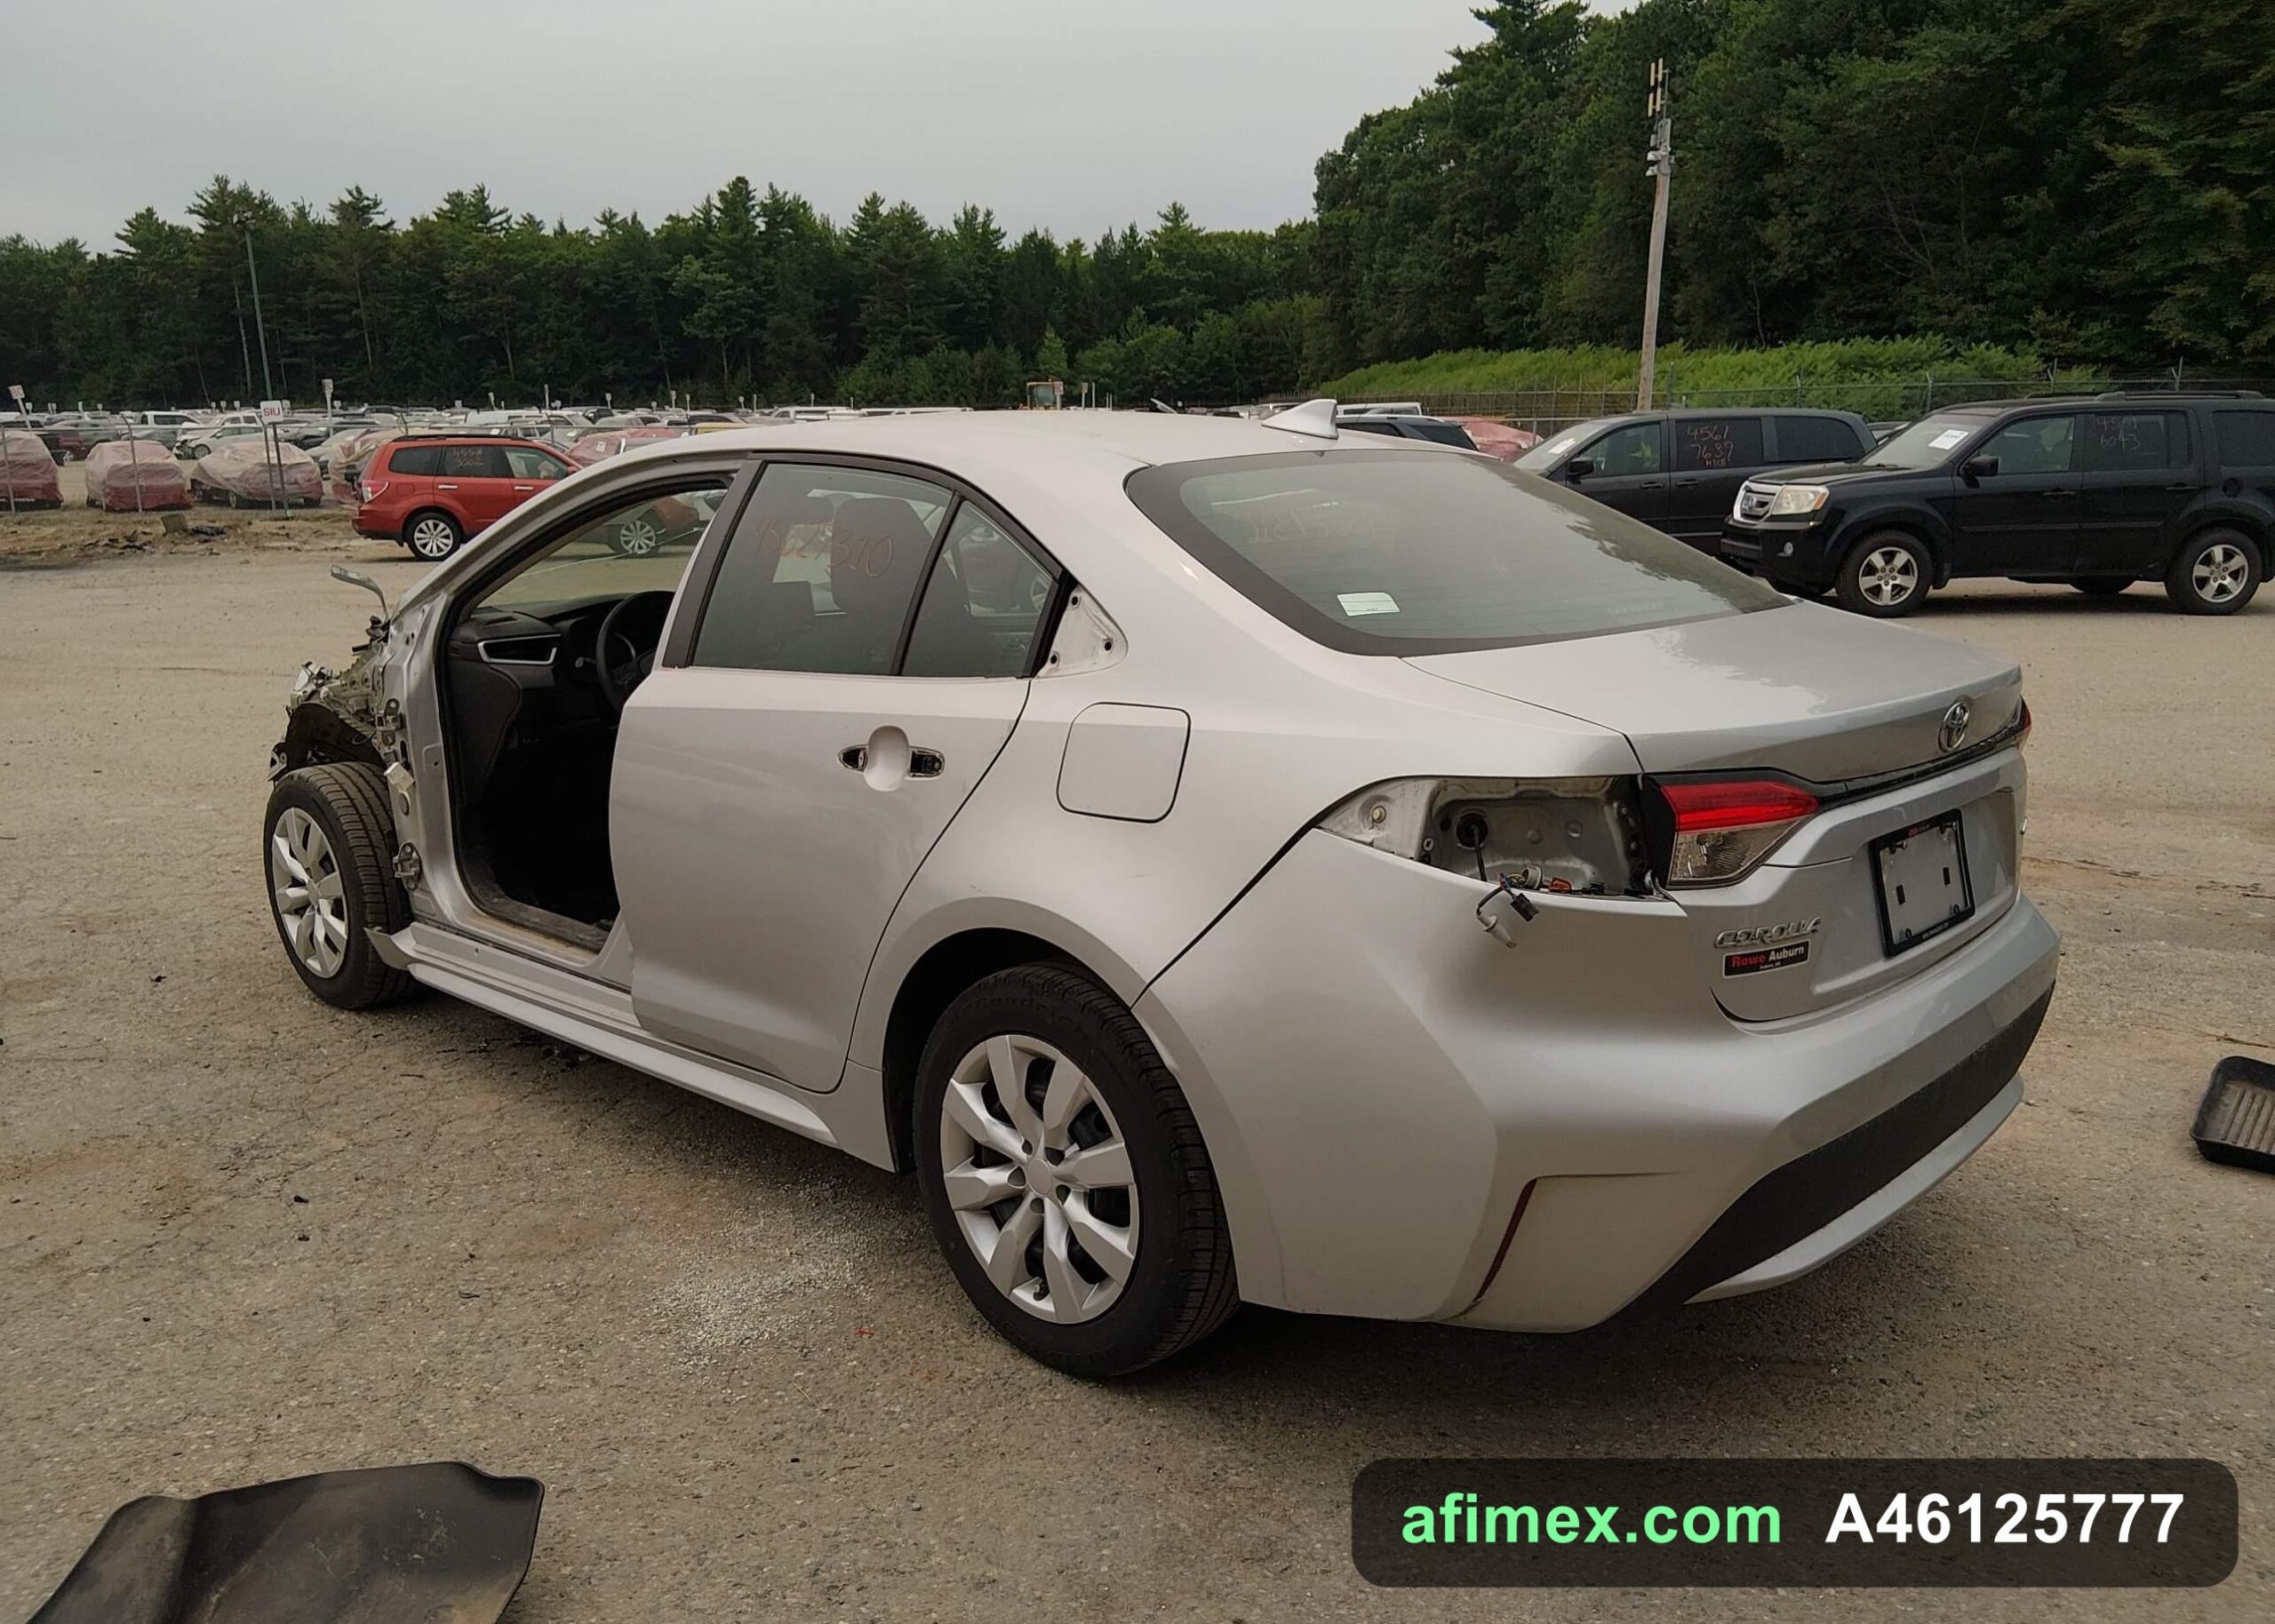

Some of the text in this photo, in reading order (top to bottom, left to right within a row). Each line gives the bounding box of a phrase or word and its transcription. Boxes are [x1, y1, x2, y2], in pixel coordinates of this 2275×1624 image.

[263, 407, 281, 418] SIU
[1687, 424, 1729, 442] 4561
[1731, 946, 1804, 967] Rowe Auburn
